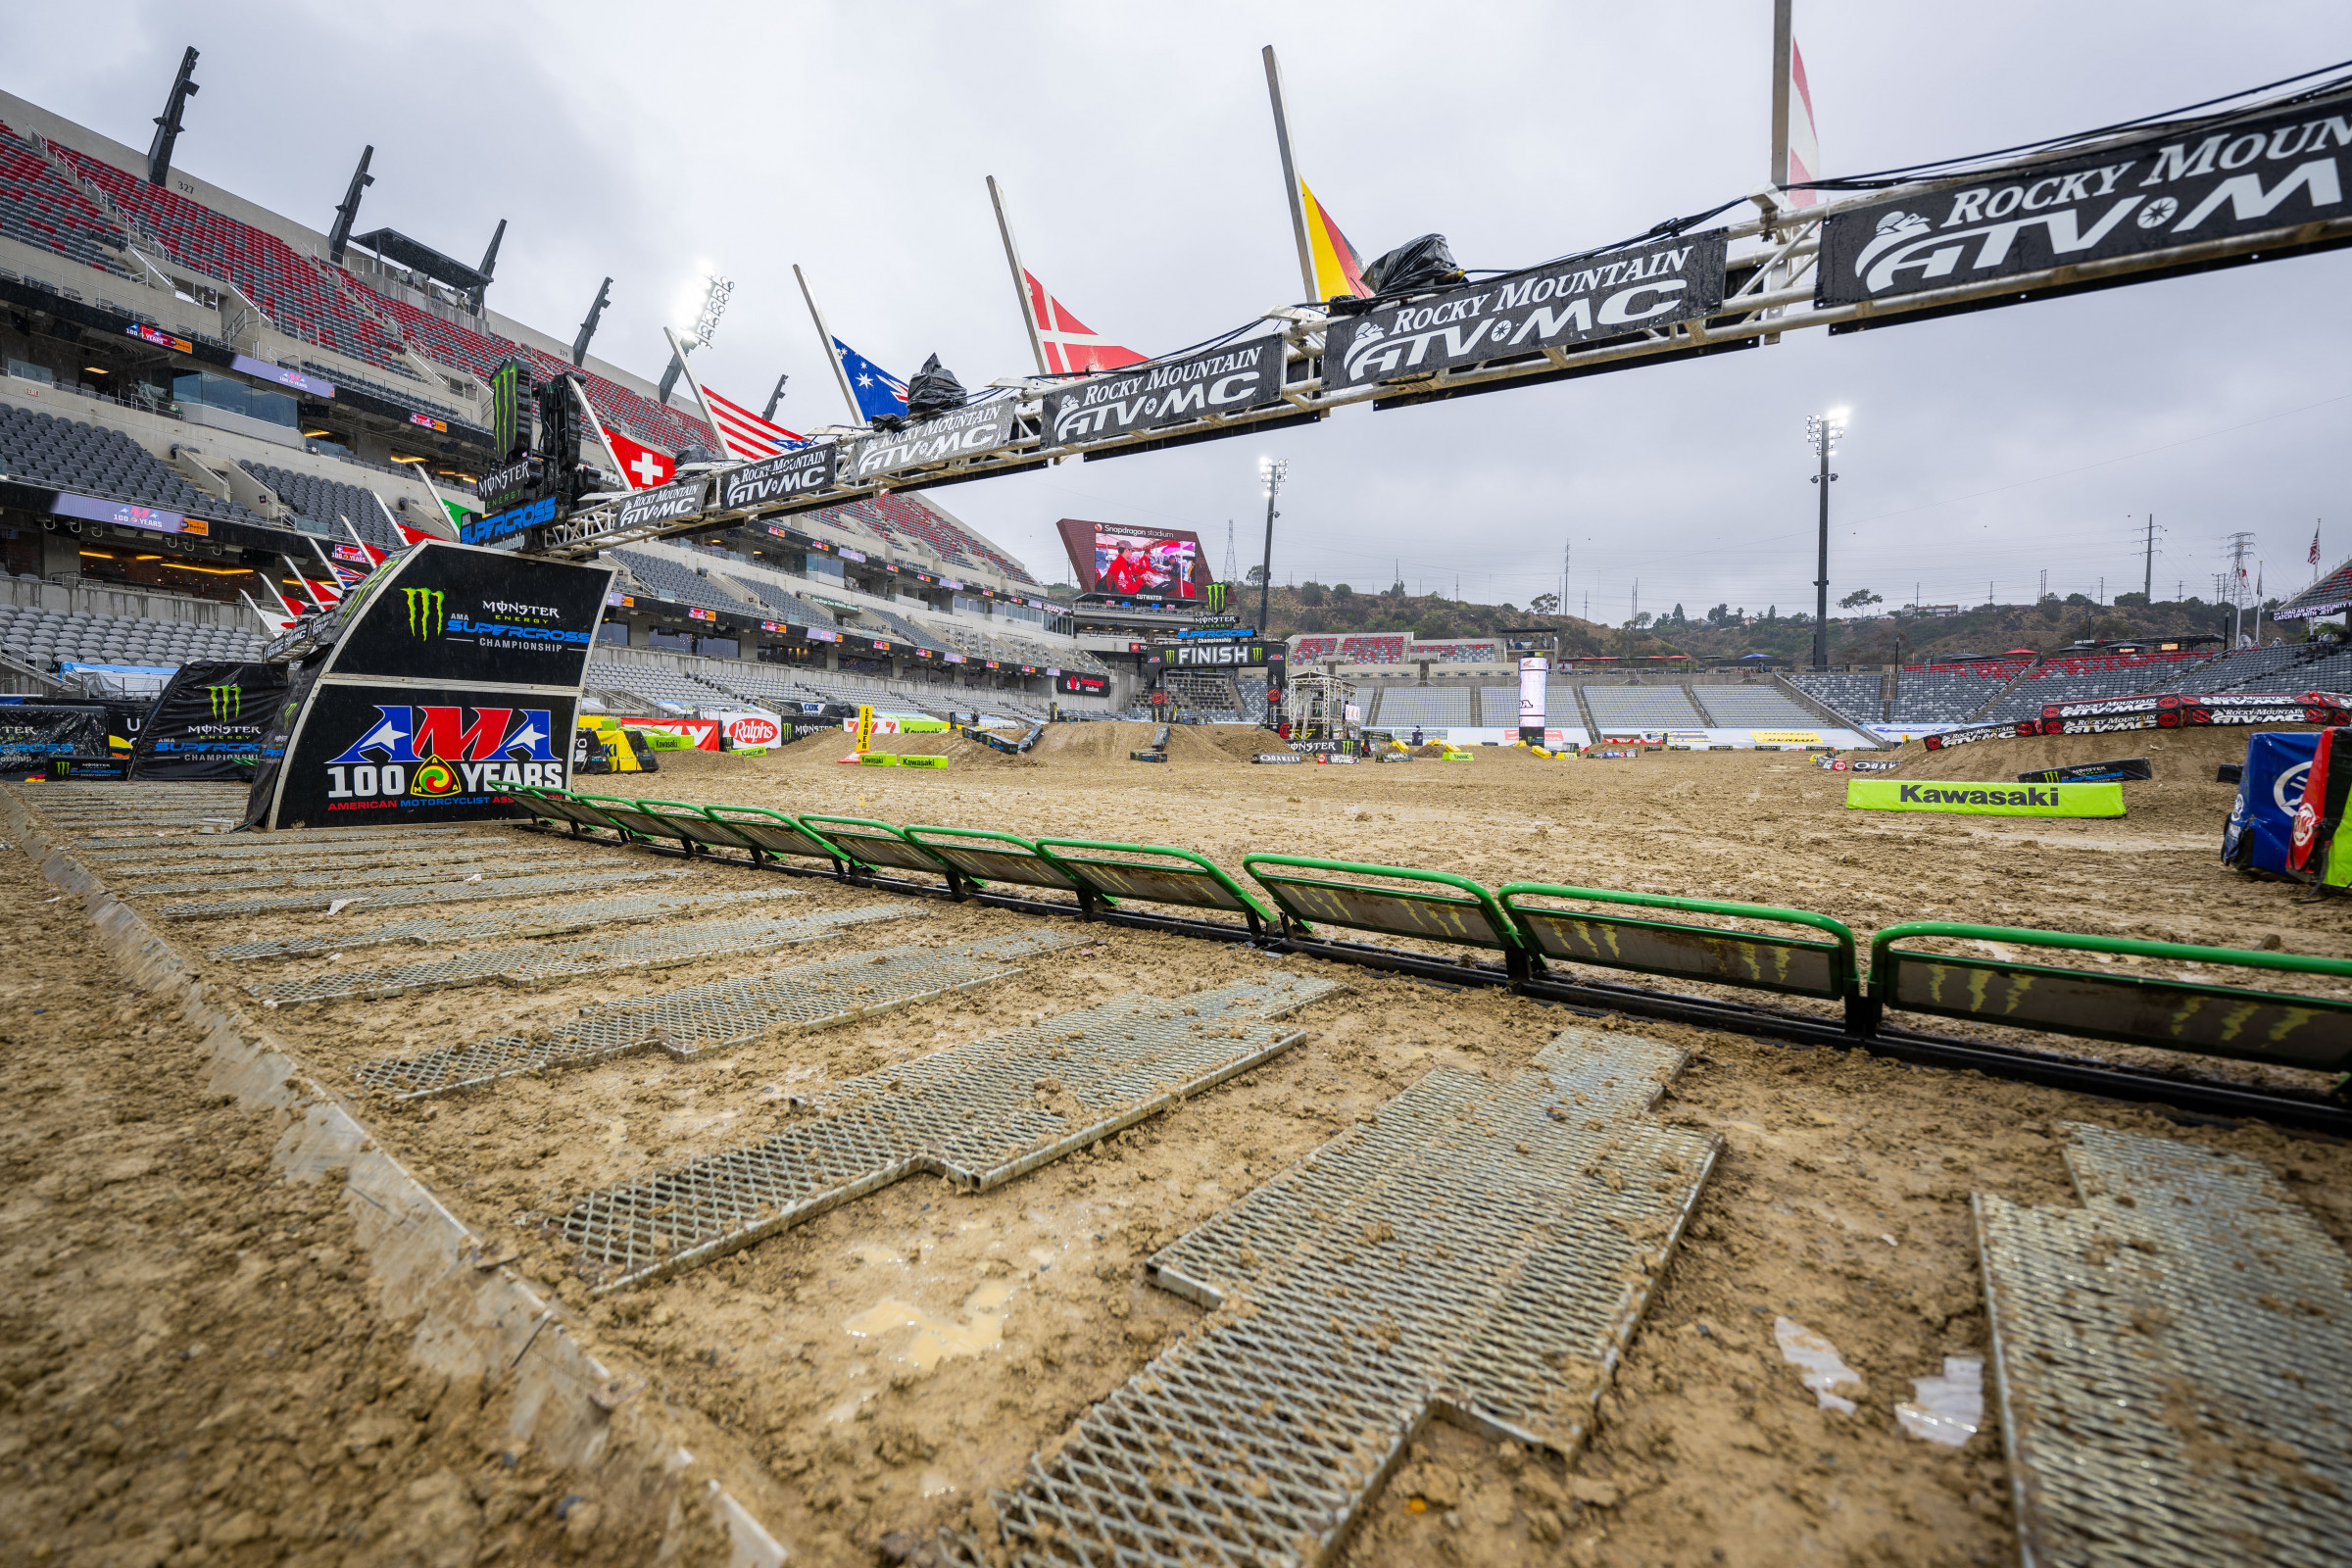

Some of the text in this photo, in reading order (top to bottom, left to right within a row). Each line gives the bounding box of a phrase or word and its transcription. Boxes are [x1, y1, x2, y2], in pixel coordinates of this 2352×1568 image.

[177, 180, 195, 194] 327
[1939, 161, 2137, 228] ROCKY
[1389, 245, 1694, 336] ROCKY MOUNTAIN
[125, 328, 138, 337] 100
[1082, 346, 1263, 408] ROCKY MOUNTAIN
[880, 405, 1003, 448] ROCKY MOUNTAIN
[741, 449, 827, 483] ROCKY MOUNTAIN
[478, 461, 530, 498] MONSTER
[486, 488, 522, 510] ENERGY
[632, 483, 701, 508] ROCKY MOUNTAIN
[113, 514, 163, 528] 100 YEARS
[460, 496, 557, 545] SUPERCROSS
[462, 513, 471, 527] AMA
[1104, 524, 1174, 538] Snapdragon stadium
[482, 600, 560, 619] MONSTER
[2305, 602, 2347, 612] OPPORTUNITY
[450, 612, 469, 621] AMA
[494, 614, 550, 624] ENERGY
[1195, 614, 1236, 625] MONSTER
[445, 619, 592, 644] SUPERCROSS
[1177, 628, 1254, 639] SUPERCROSS
[478, 637, 563, 653] CHAMPIONSHIP
[1178, 645, 1249, 665] FINISH
[1080, 676, 1104, 687] Snapdragon
[804, 703, 819, 711] COX
[2106, 698, 2157, 707] MOUNTAIN
[2107, 714, 2157, 724] MOUNTAIN
[187, 723, 263, 734] MONSTER
[323, 705, 563, 764] AMA
[734, 720, 774, 743] Ralphs
[795, 723, 833, 734] MONST
[861, 708, 870, 750] LEADER
[1952, 730, 1975, 739] ROCKY
[1976, 725, 2015, 735] MOUNTAIN
[656, 739, 678, 749] Kawasaki
[903, 758, 935, 766] Kawasaki
[2072, 765, 2107, 774] MONSTER
[326, 762, 564, 799] 100 YEARS
[2060, 771, 2124, 783] SUPERCROSS
[1900, 784, 2059, 807] Kawasaki
[327, 800, 398, 811] AMERICAN
[400, 796, 491, 808] MOTORCYCLIST
